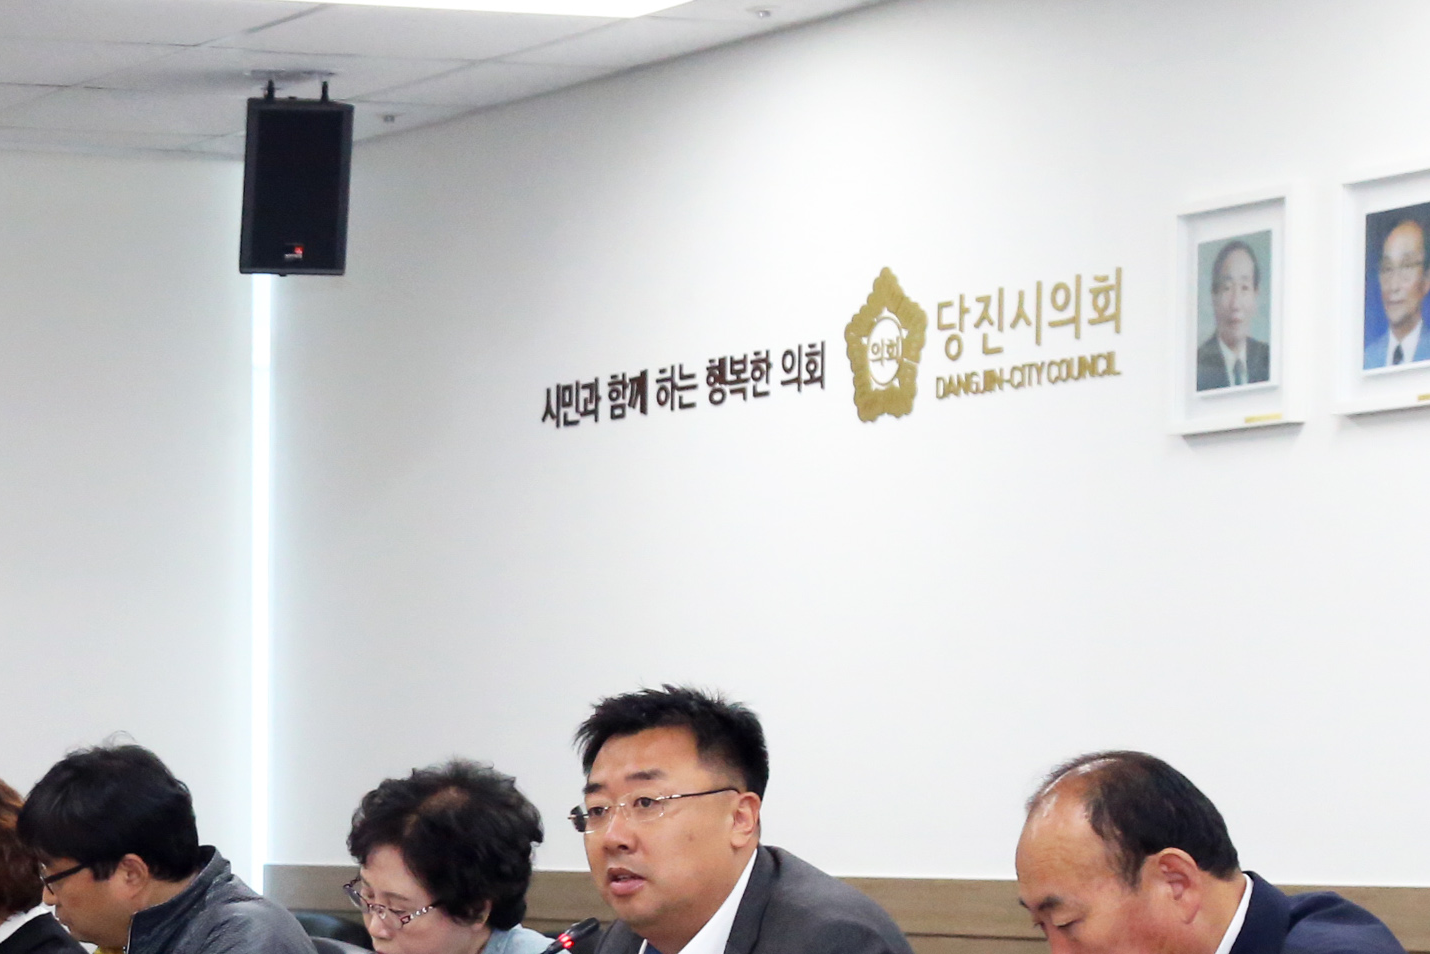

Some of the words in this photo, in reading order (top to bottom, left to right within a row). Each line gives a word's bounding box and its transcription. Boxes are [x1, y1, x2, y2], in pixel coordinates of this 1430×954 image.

[937, 267, 1122, 361] 당진시의회
[541, 376, 601, 428] 시민과
[607, 369, 648, 420] 함께
[656, 363, 698, 411] 하는
[706, 349, 773, 405] 행복한
[780, 341, 826, 392] 의회
[1047, 352, 1122, 385] COUNCIL
